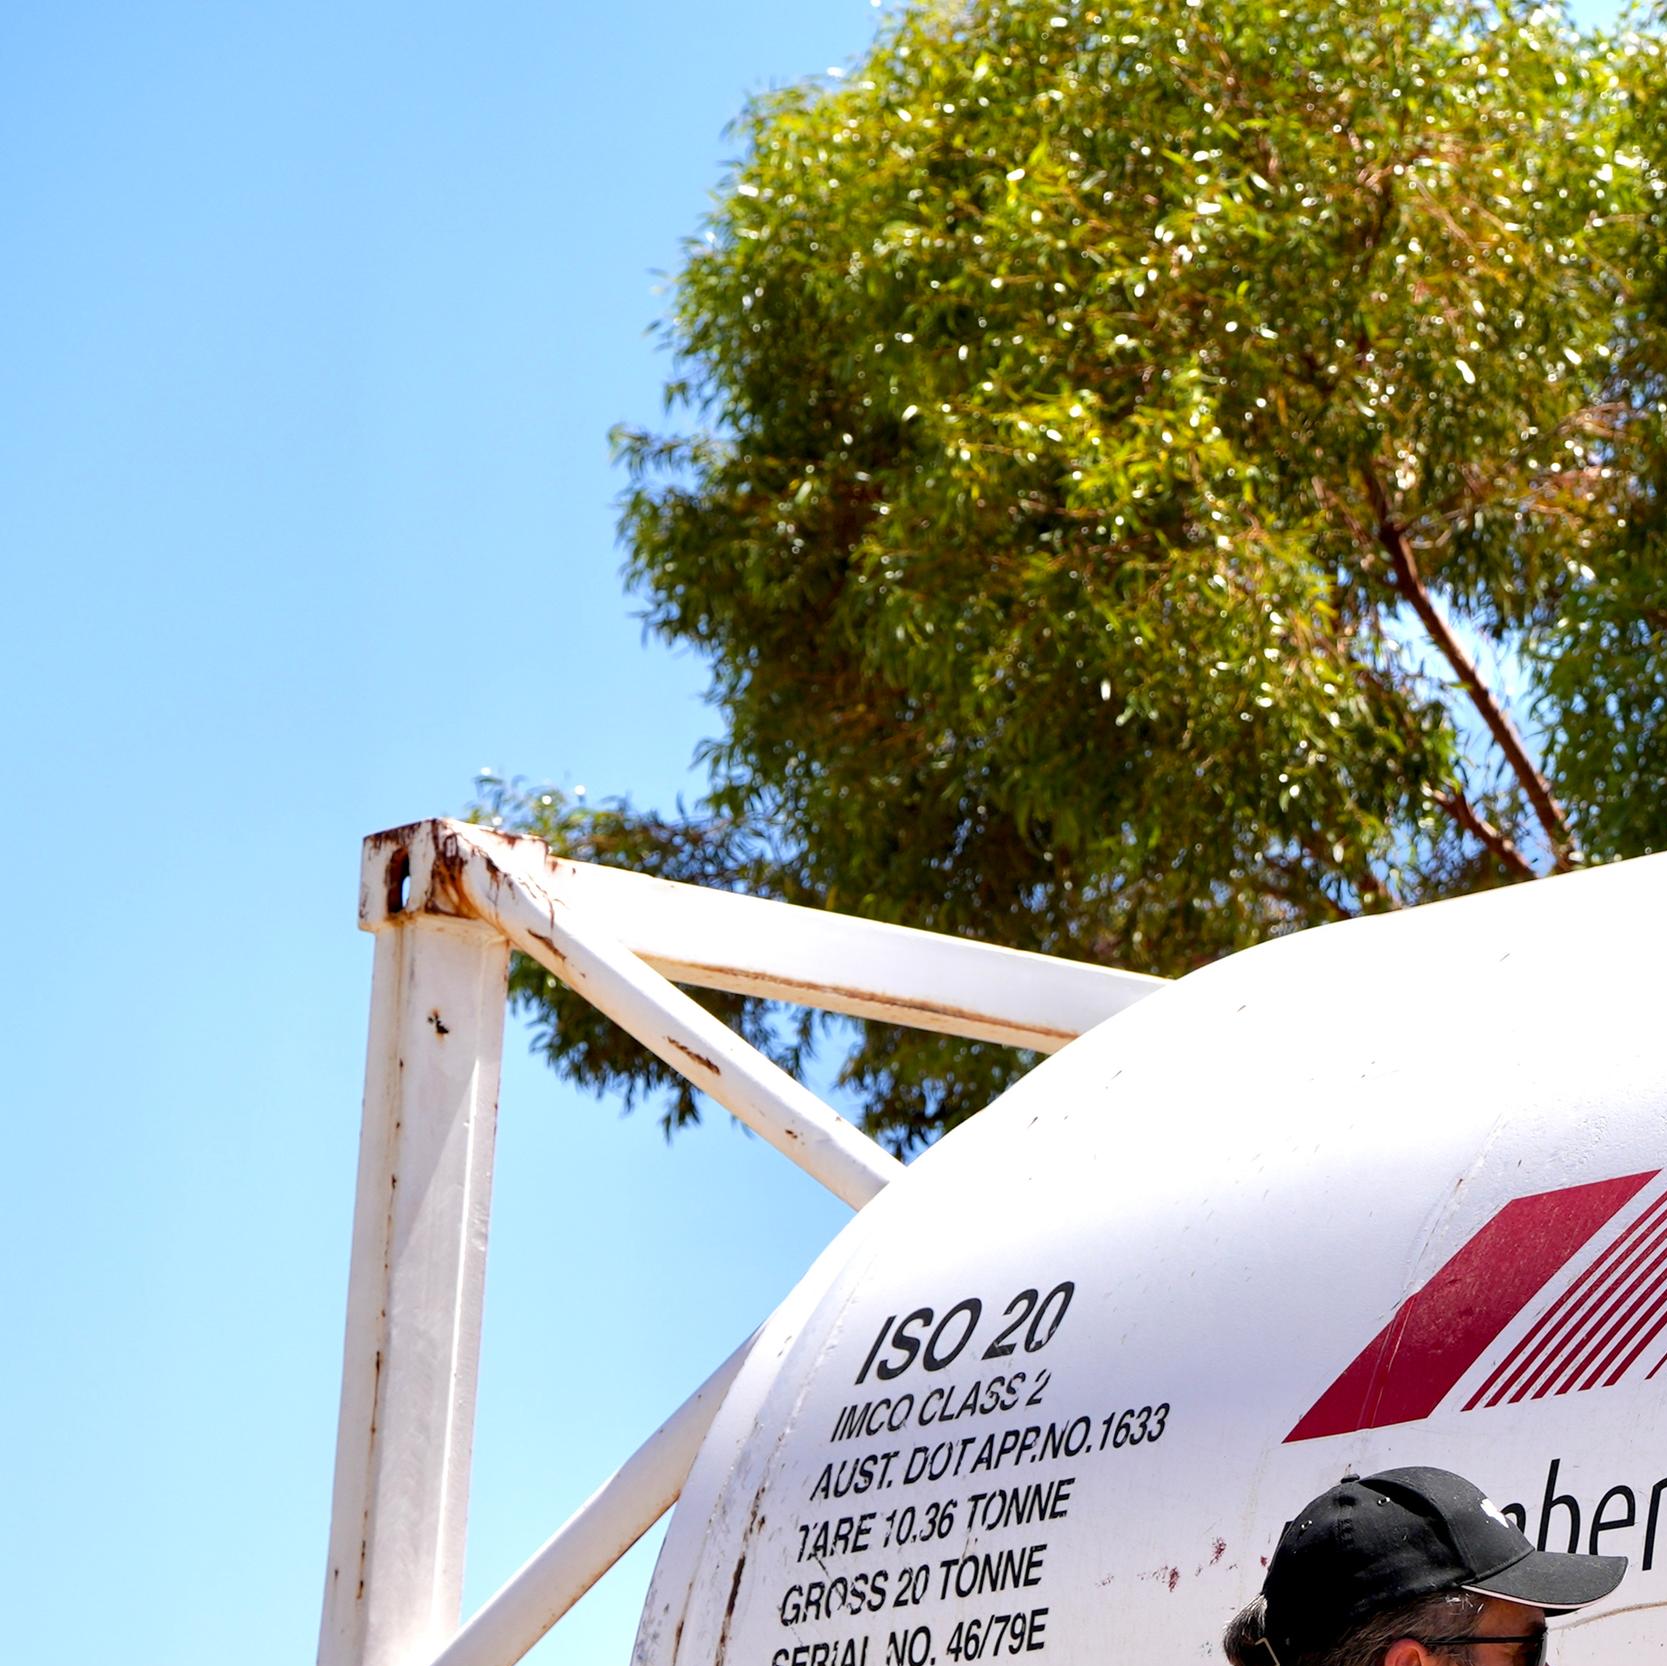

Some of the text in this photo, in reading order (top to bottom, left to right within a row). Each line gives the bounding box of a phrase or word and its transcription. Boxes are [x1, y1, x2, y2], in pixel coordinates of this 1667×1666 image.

[854, 1281, 1075, 1385] ISO 20
[830, 1369, 1051, 1442] IMCO CLASS 2
[810, 1451, 900, 1501] AUST.
[903, 1437, 976, 1485] DOT
[1099, 1403, 1170, 1450] 1633
[797, 1478, 1076, 1564] TARE 10.36 TONNE
[778, 1544, 1047, 1626] GROSS 20 TONNE
[946, 1607, 1049, 1662] 46/79E
